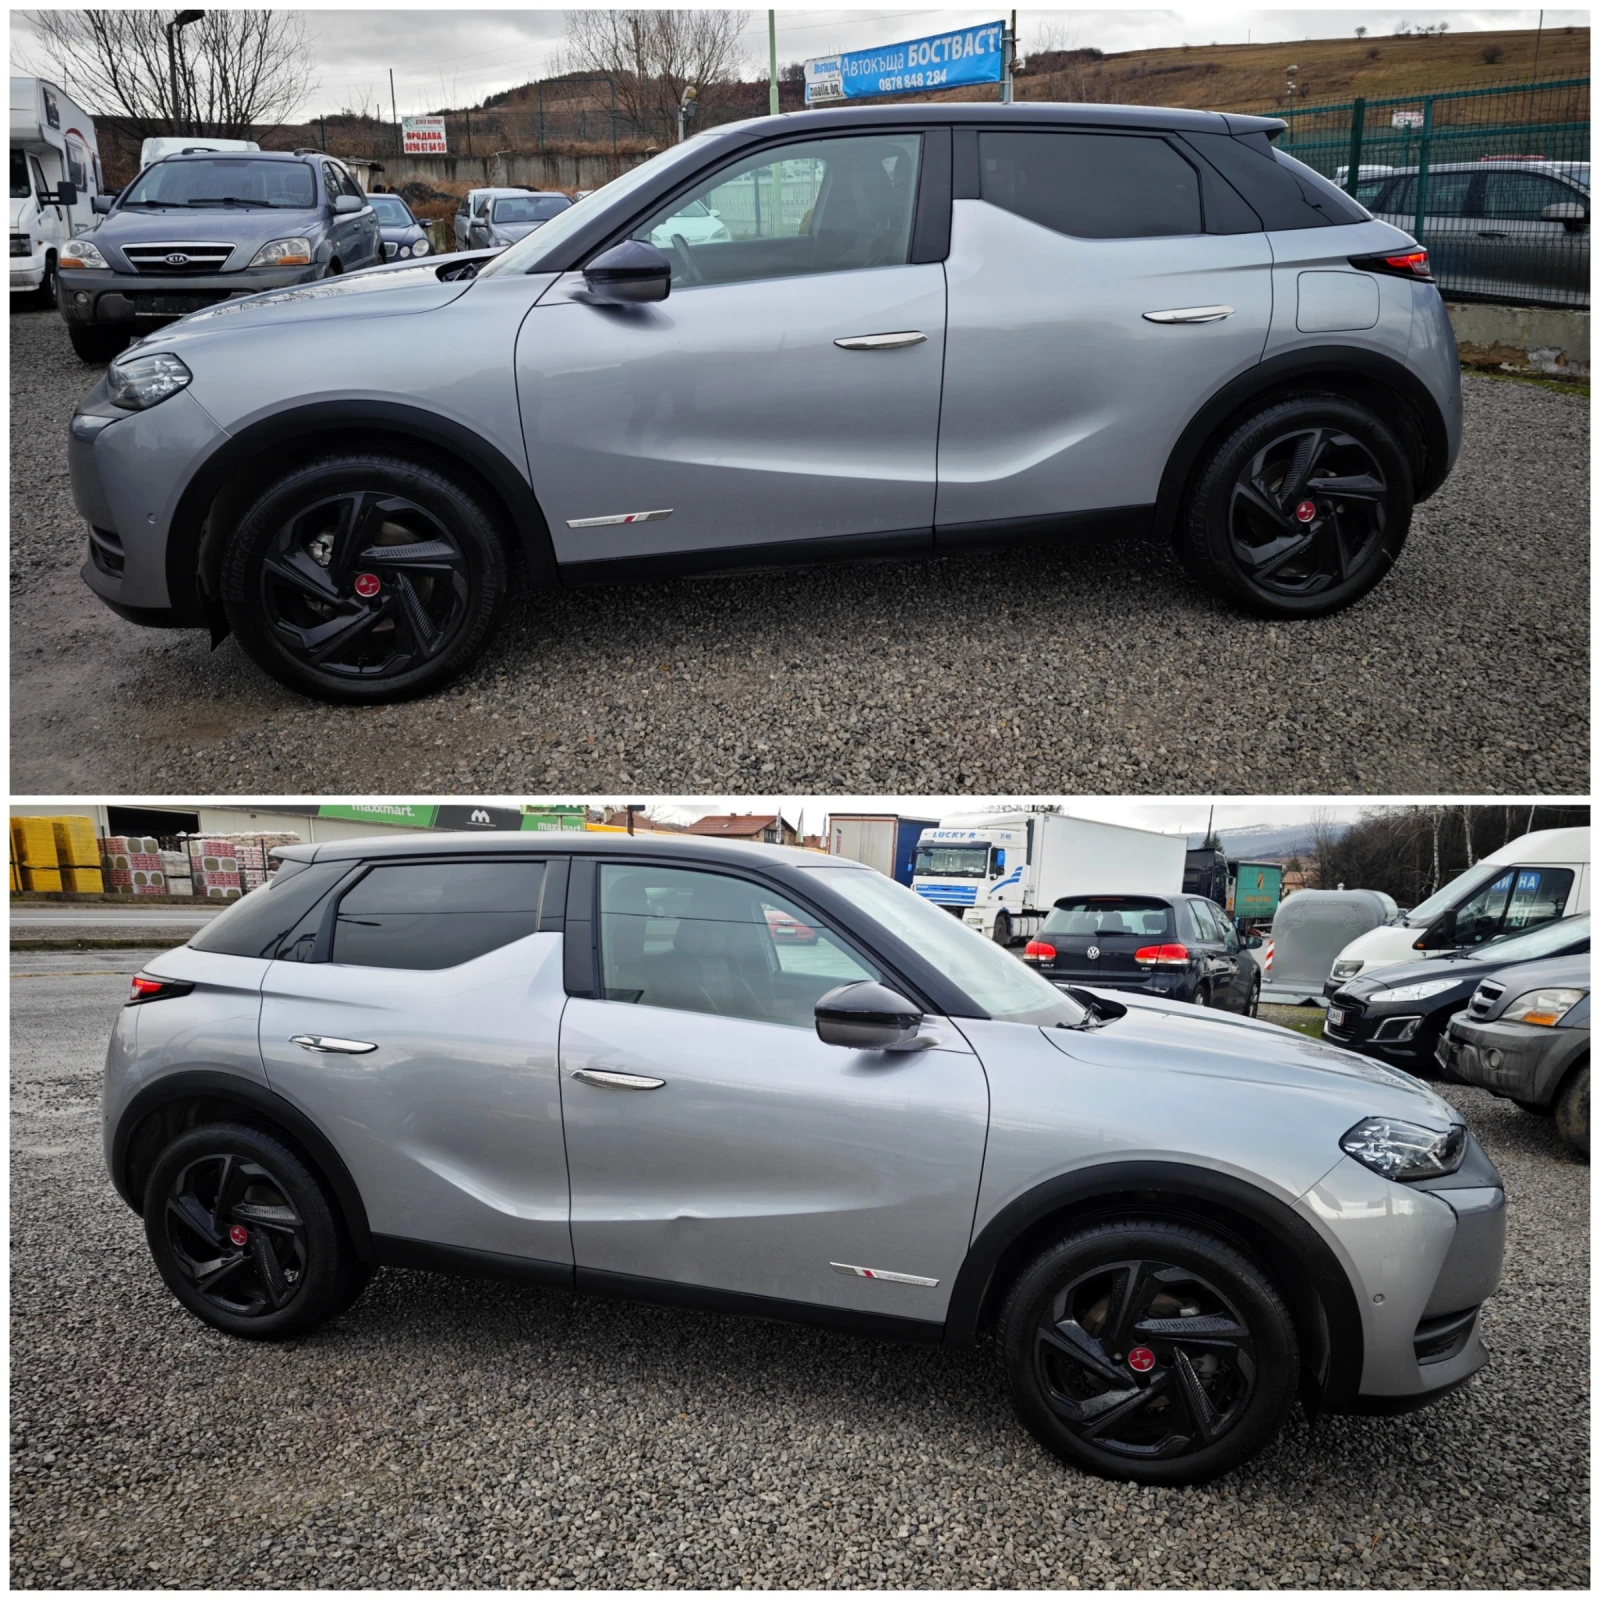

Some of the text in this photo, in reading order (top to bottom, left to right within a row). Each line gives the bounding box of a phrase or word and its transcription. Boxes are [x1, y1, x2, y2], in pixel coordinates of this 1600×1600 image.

[842, 27, 999, 77] Автокъща БОСТВАСТ
[879, 68, 947, 91] 0878 848 284
[406, 132, 442, 141] ПРОДАВА
[932, 831, 976, 839] LUCKY R
